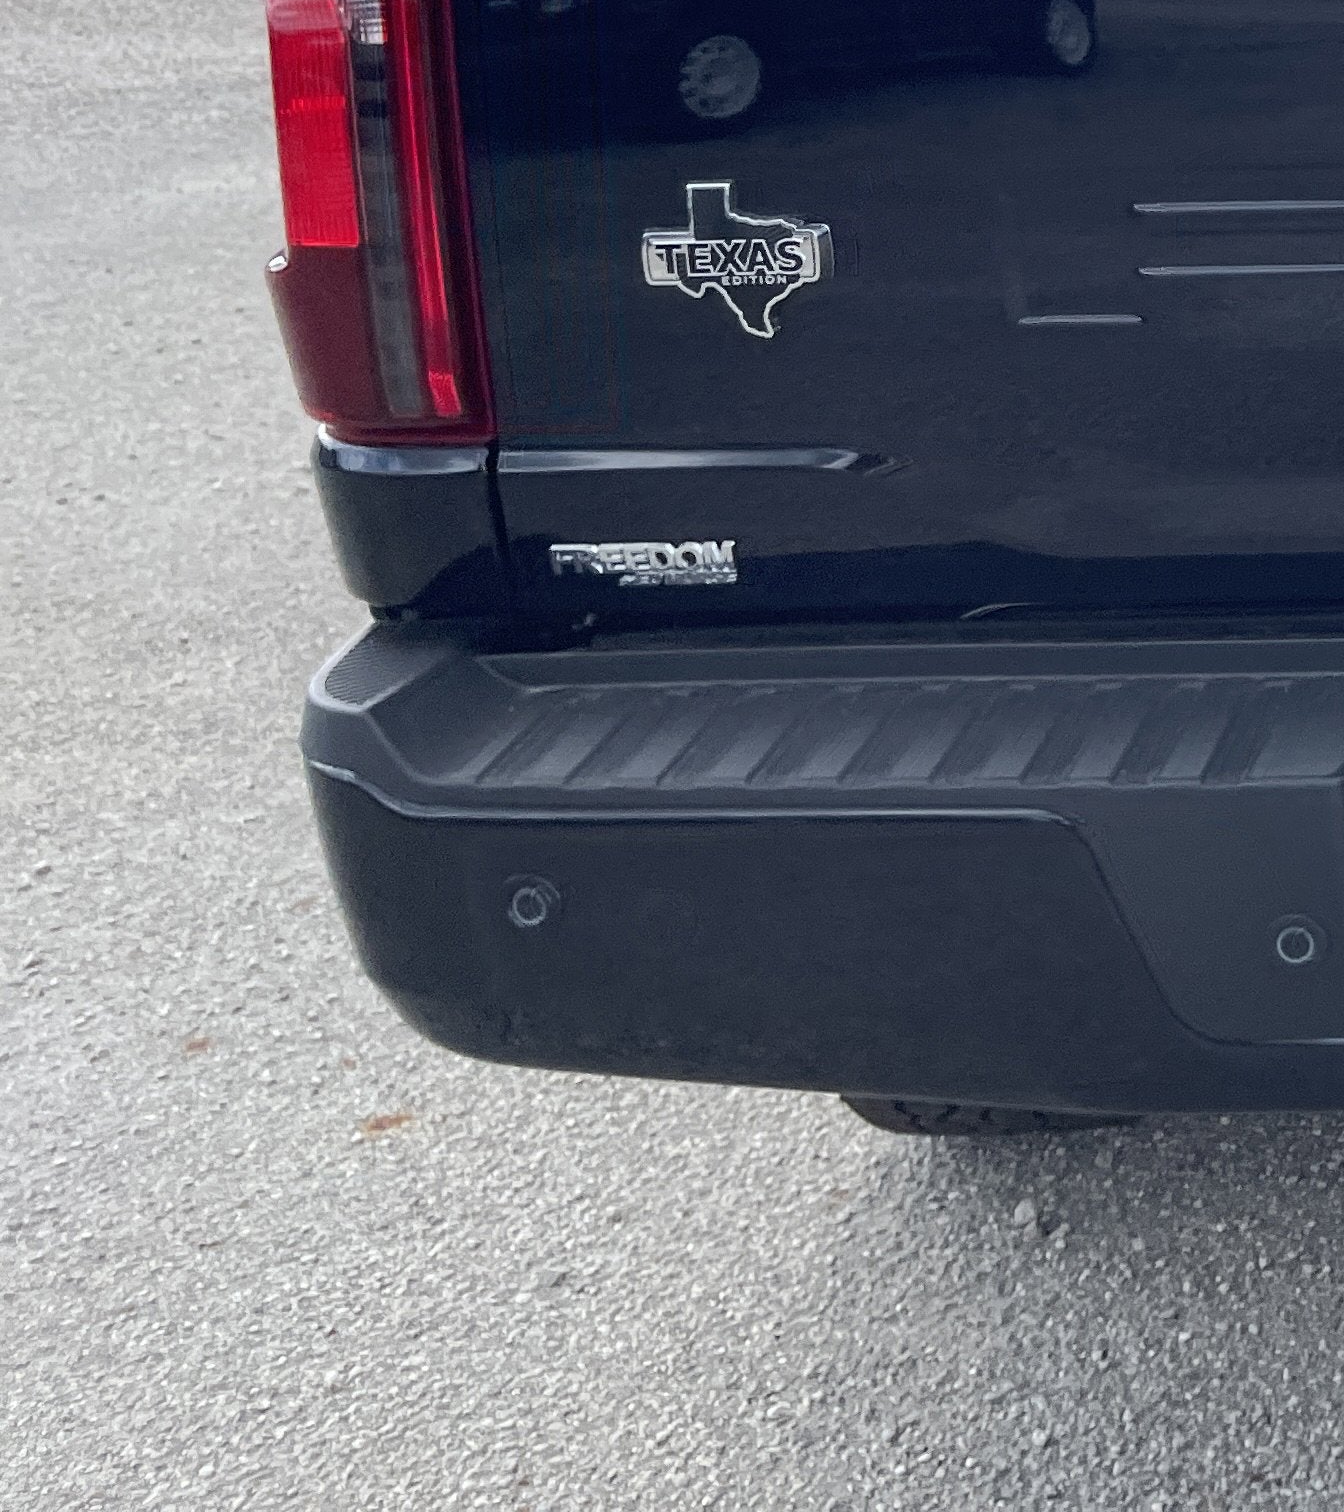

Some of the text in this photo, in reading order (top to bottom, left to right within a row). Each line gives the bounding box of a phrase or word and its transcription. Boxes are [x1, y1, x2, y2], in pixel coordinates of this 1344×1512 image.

[655, 239, 805, 276] TEXAS
[721, 275, 788, 286] EDITION
[548, 541, 736, 575] FREEDOM
